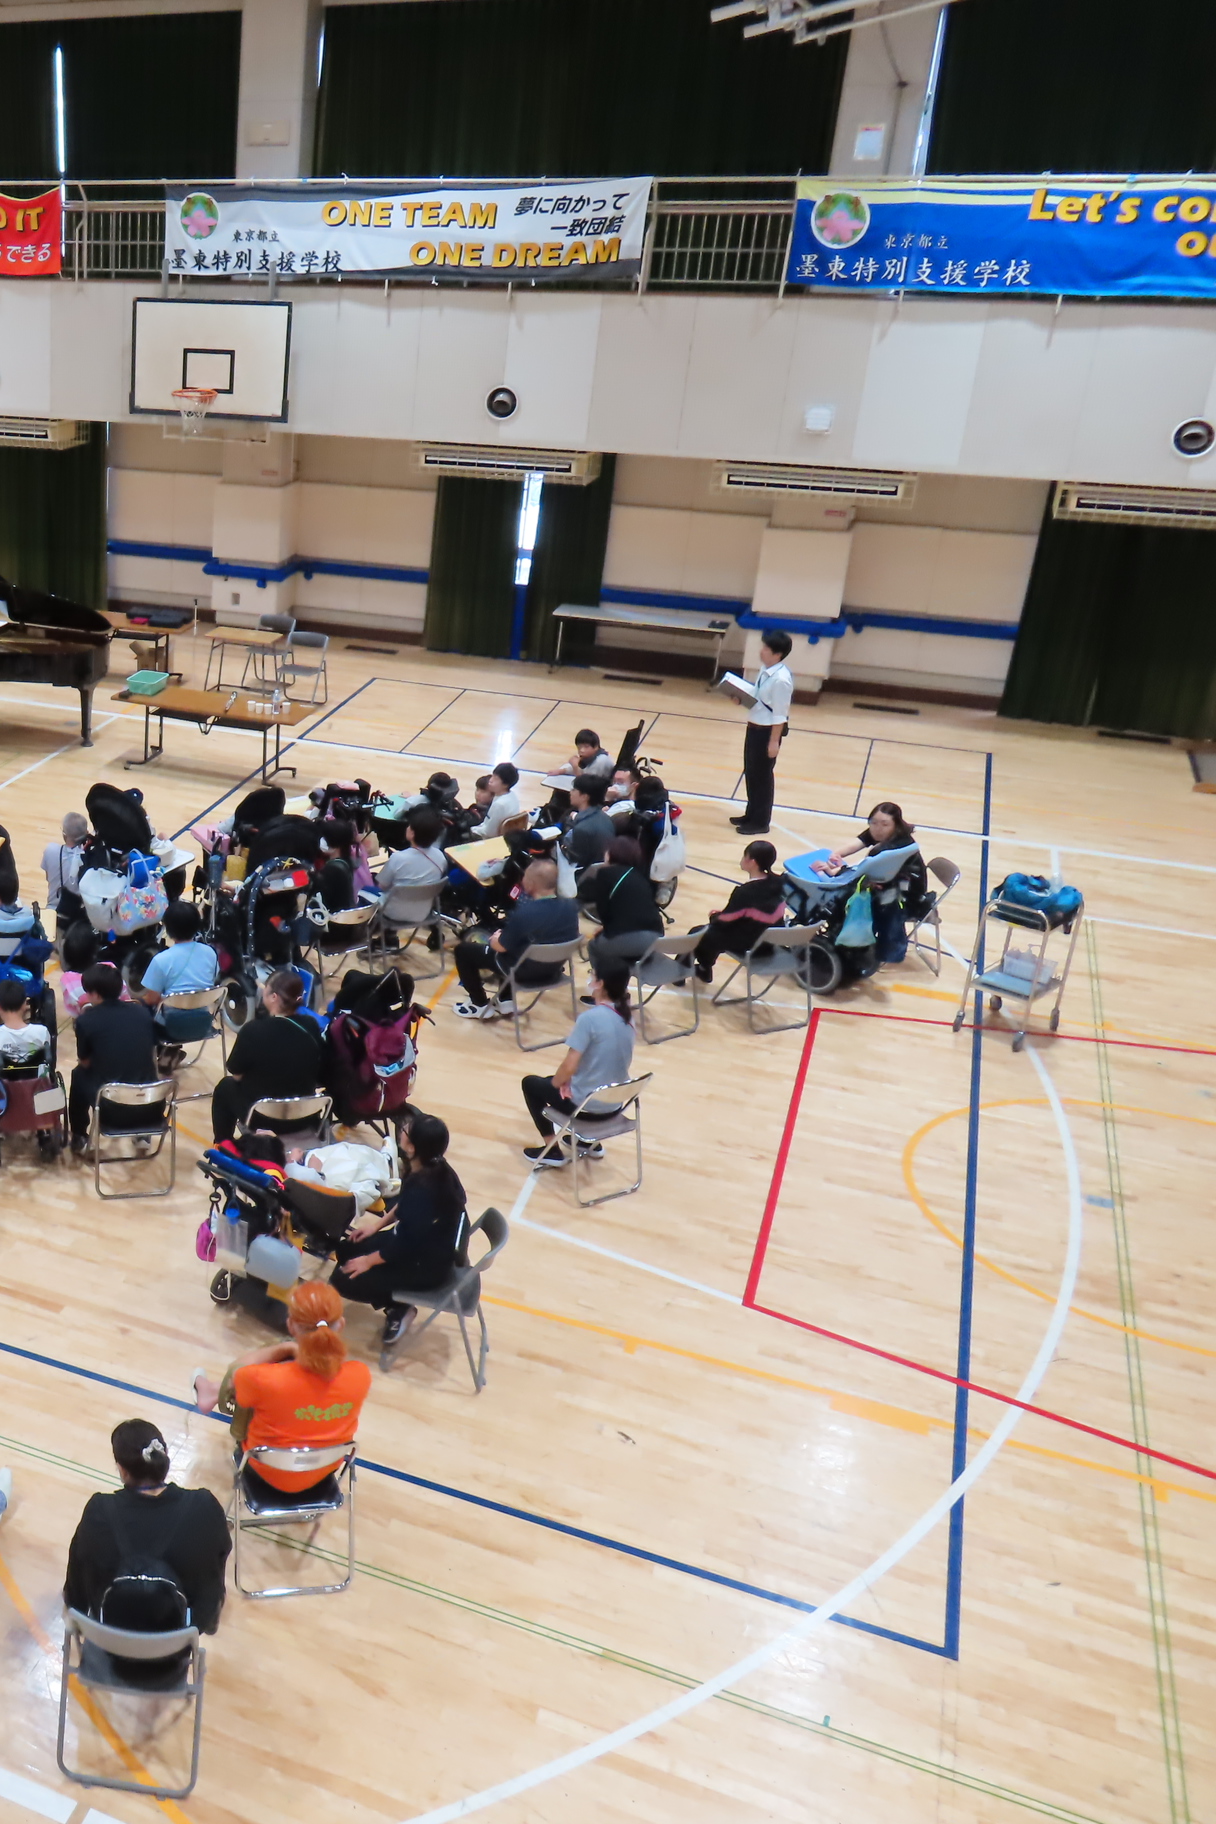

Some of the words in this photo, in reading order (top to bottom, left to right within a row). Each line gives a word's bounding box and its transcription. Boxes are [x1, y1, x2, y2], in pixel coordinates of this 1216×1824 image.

[321, 201, 393, 228] ONE
[401, 201, 498, 229] TEAM
[514, 192, 630, 216] 夢に向かって
[1028, 188, 1143, 224] Let's
[1153, 195, 1216, 224] co
[15, 207, 45, 232] IT
[550, 214, 626, 237] 一致団結
[233, 229, 280, 243] 東京都立
[885, 233, 949, 249] 東京都立
[1176, 231, 1216, 258] o
[170, 249, 343, 273] 墨東特別支援学校
[409, 241, 485, 267] ONE
[491, 237, 622, 268] DREAM
[795, 253, 1033, 287] 墨東特別支援学校
